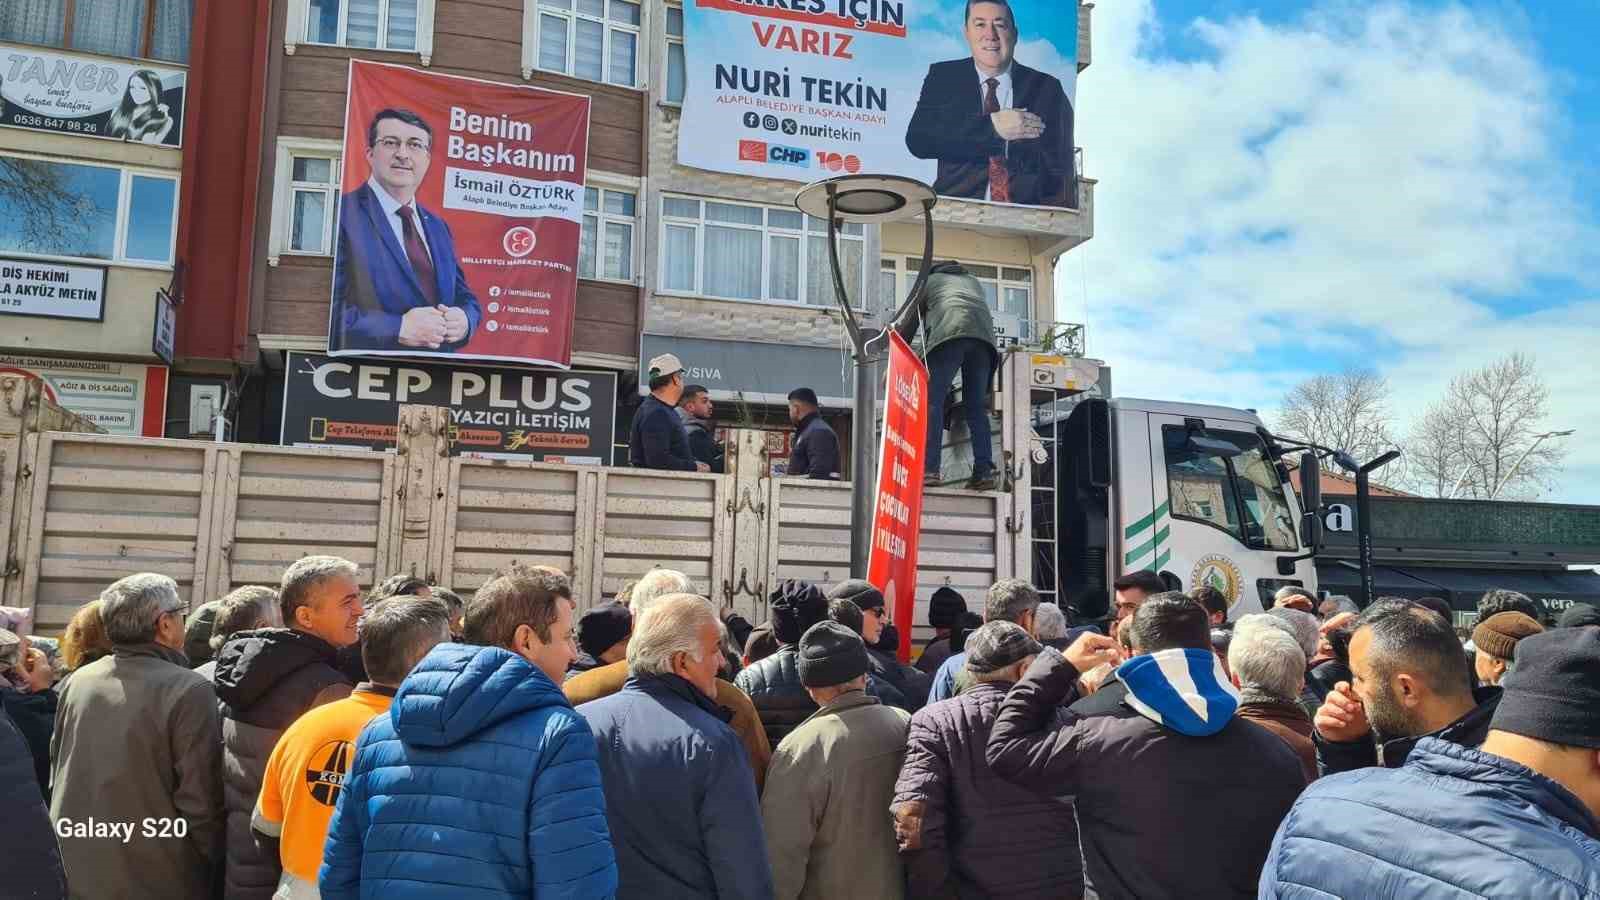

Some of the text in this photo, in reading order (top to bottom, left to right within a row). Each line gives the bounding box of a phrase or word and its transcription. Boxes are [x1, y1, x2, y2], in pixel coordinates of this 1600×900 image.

[751, 21, 853, 59] VARIZ
[7, 54, 119, 95] TANER
[715, 63, 887, 111] NURİ TEKİN
[14, 114, 97, 133] 0536 647 98 26
[449, 106, 531, 142] Benim
[716, 93, 753, 105] ALAPLI
[755, 98, 804, 114] BELEDİYE
[853, 111, 887, 125] ADAYI
[799, 123, 862, 142] nuritekin
[447, 135, 576, 173] Başkanım
[769, 146, 806, 165] CHP
[454, 172, 576, 202] İsmail ÖZTÜRK
[2, 266, 70, 284] DİŞ HEKİMİ
[15, 283, 56, 299] AKYÜZ
[58, 287, 97, 302] METİN
[312, 361, 592, 412] CEP PLUS
[450, 409, 591, 431] YAZICI İLETİŞİM
[1541, 598, 1575, 610] vera
